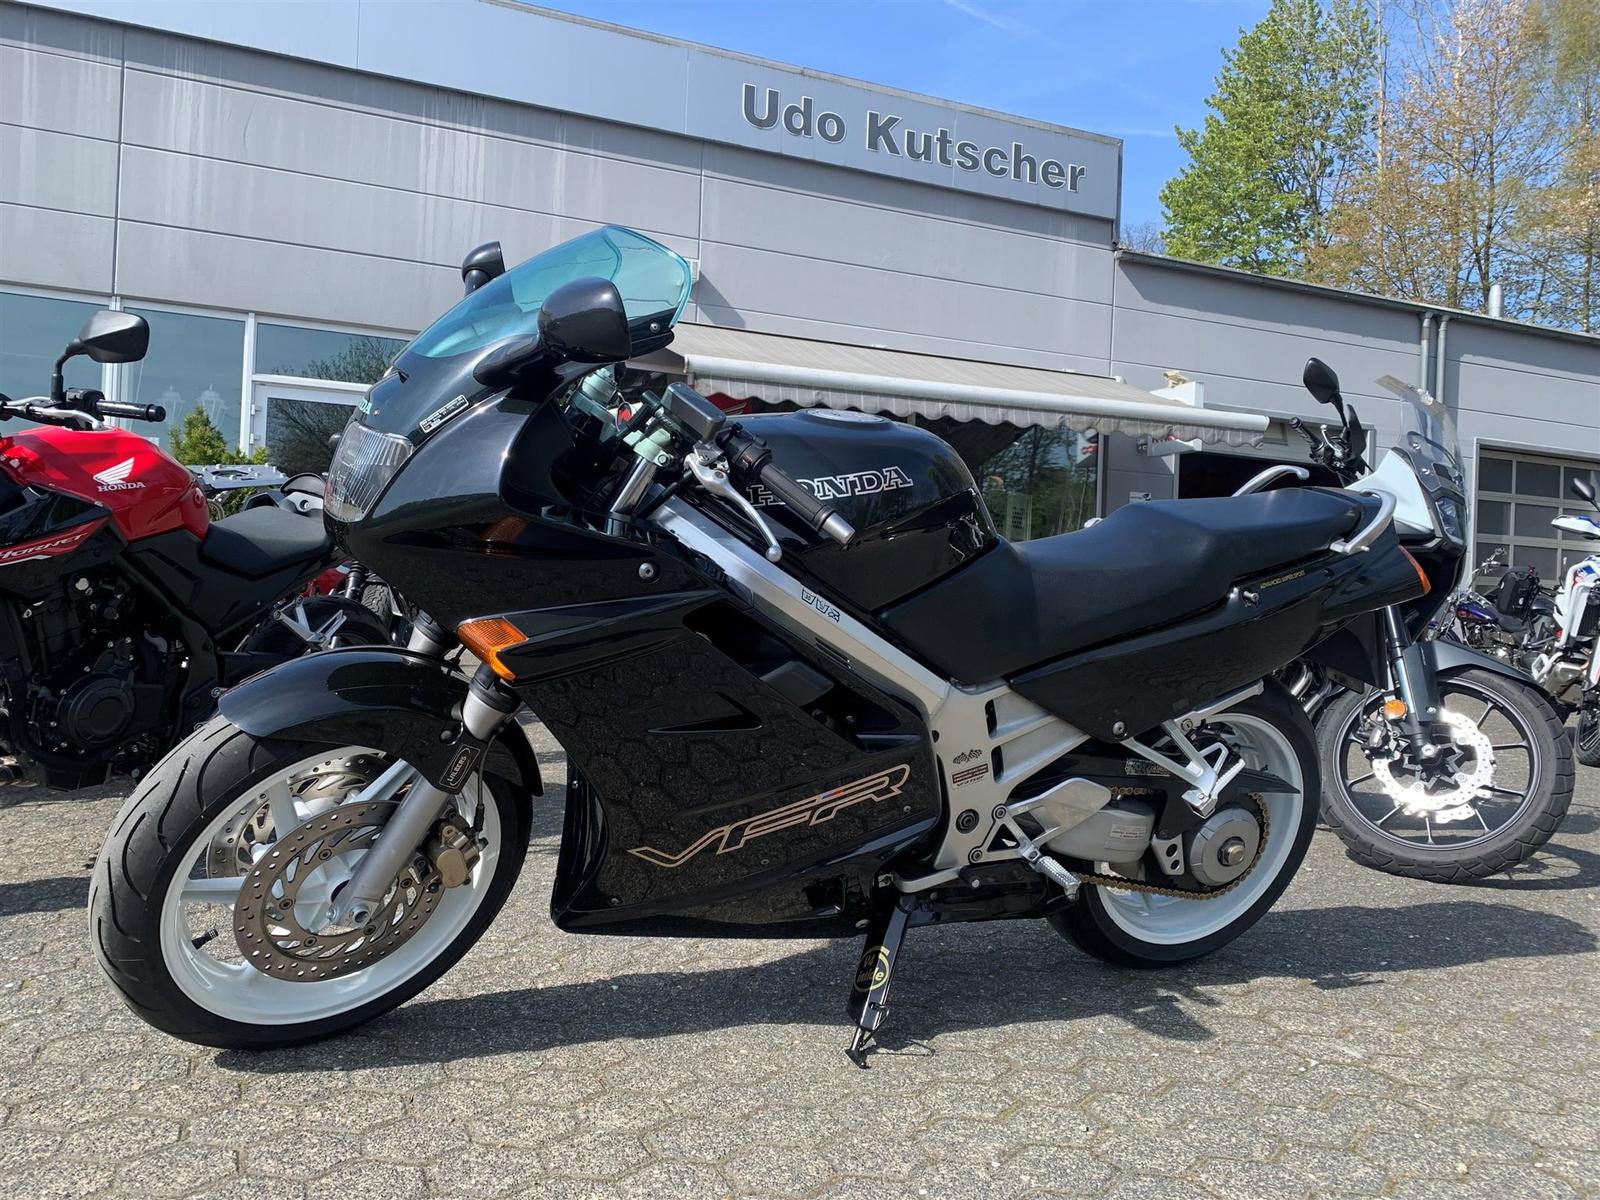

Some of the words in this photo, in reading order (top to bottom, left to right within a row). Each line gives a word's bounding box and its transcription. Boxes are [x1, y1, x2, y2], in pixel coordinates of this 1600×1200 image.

[742, 82, 847, 144] Udo
[865, 109, 1086, 193] Kutscher
[97, 481, 146, 492] HONDA
[627, 763, 911, 868] VFR
